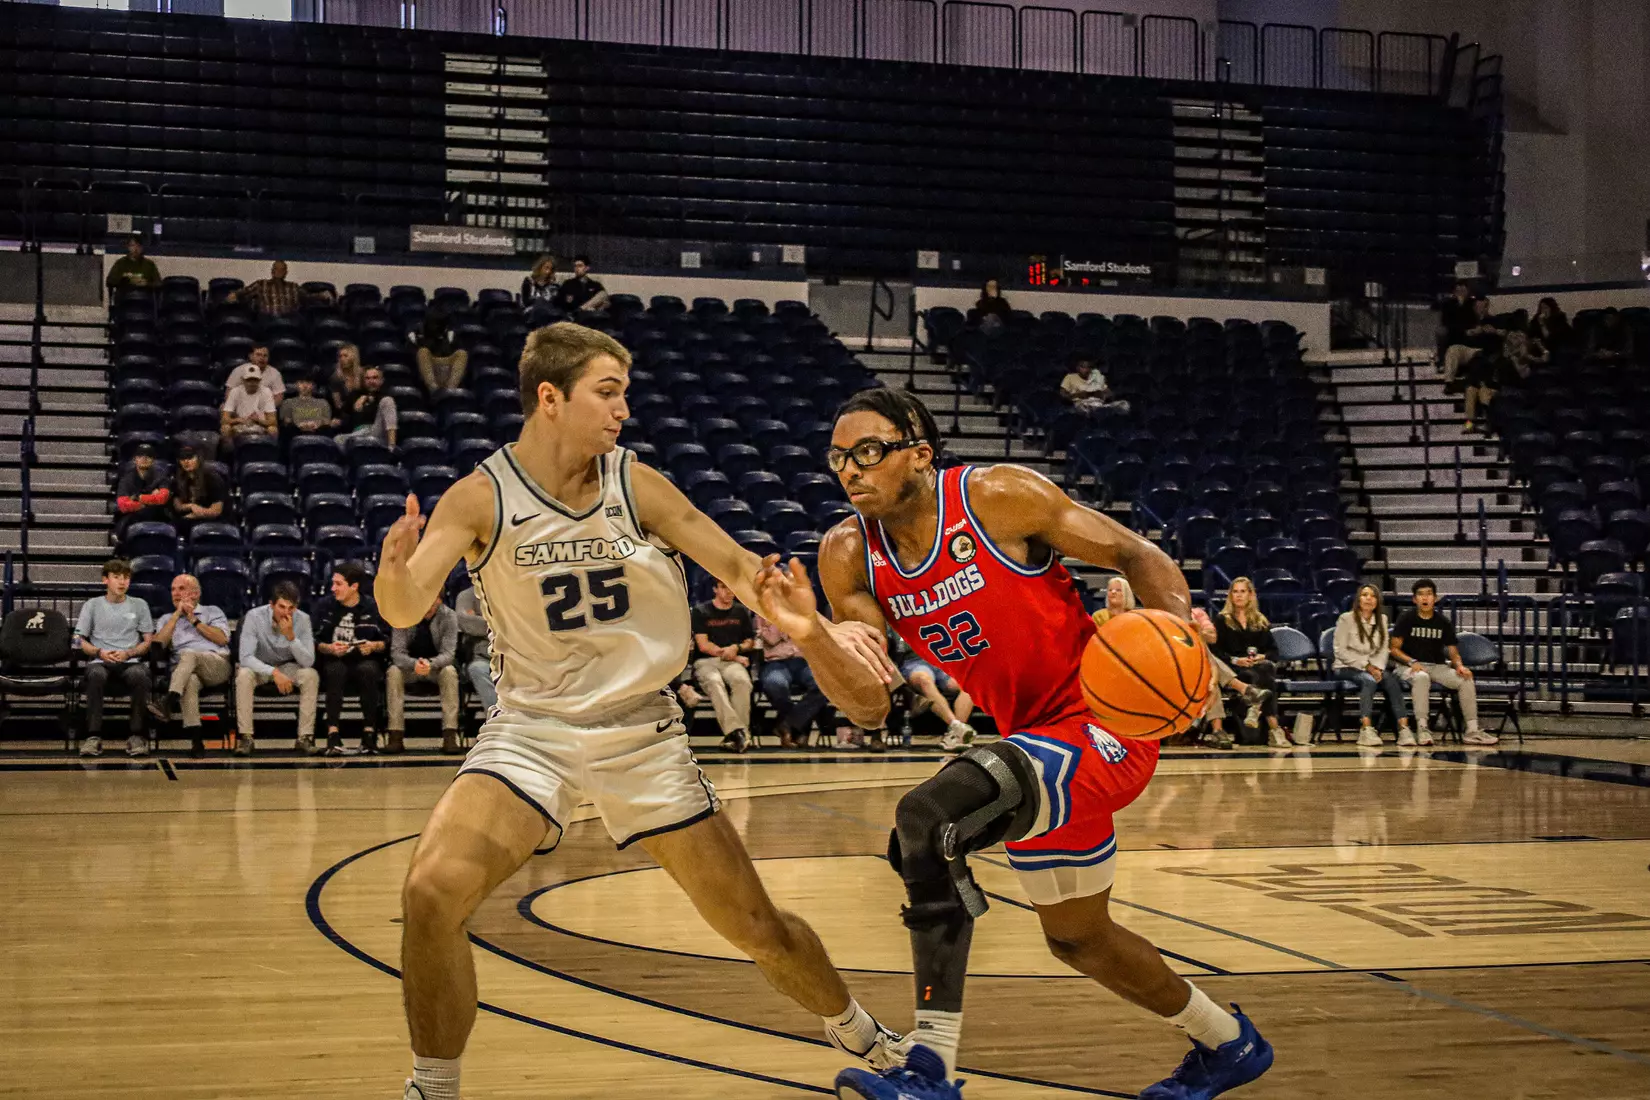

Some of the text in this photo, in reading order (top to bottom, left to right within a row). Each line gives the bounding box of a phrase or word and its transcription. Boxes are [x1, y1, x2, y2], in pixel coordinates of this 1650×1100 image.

[1064, 260, 1151, 274] Samford Students
[515, 535, 636, 566] SAMFORD
[540, 565, 631, 631] 25
[919, 610, 991, 663] 22
